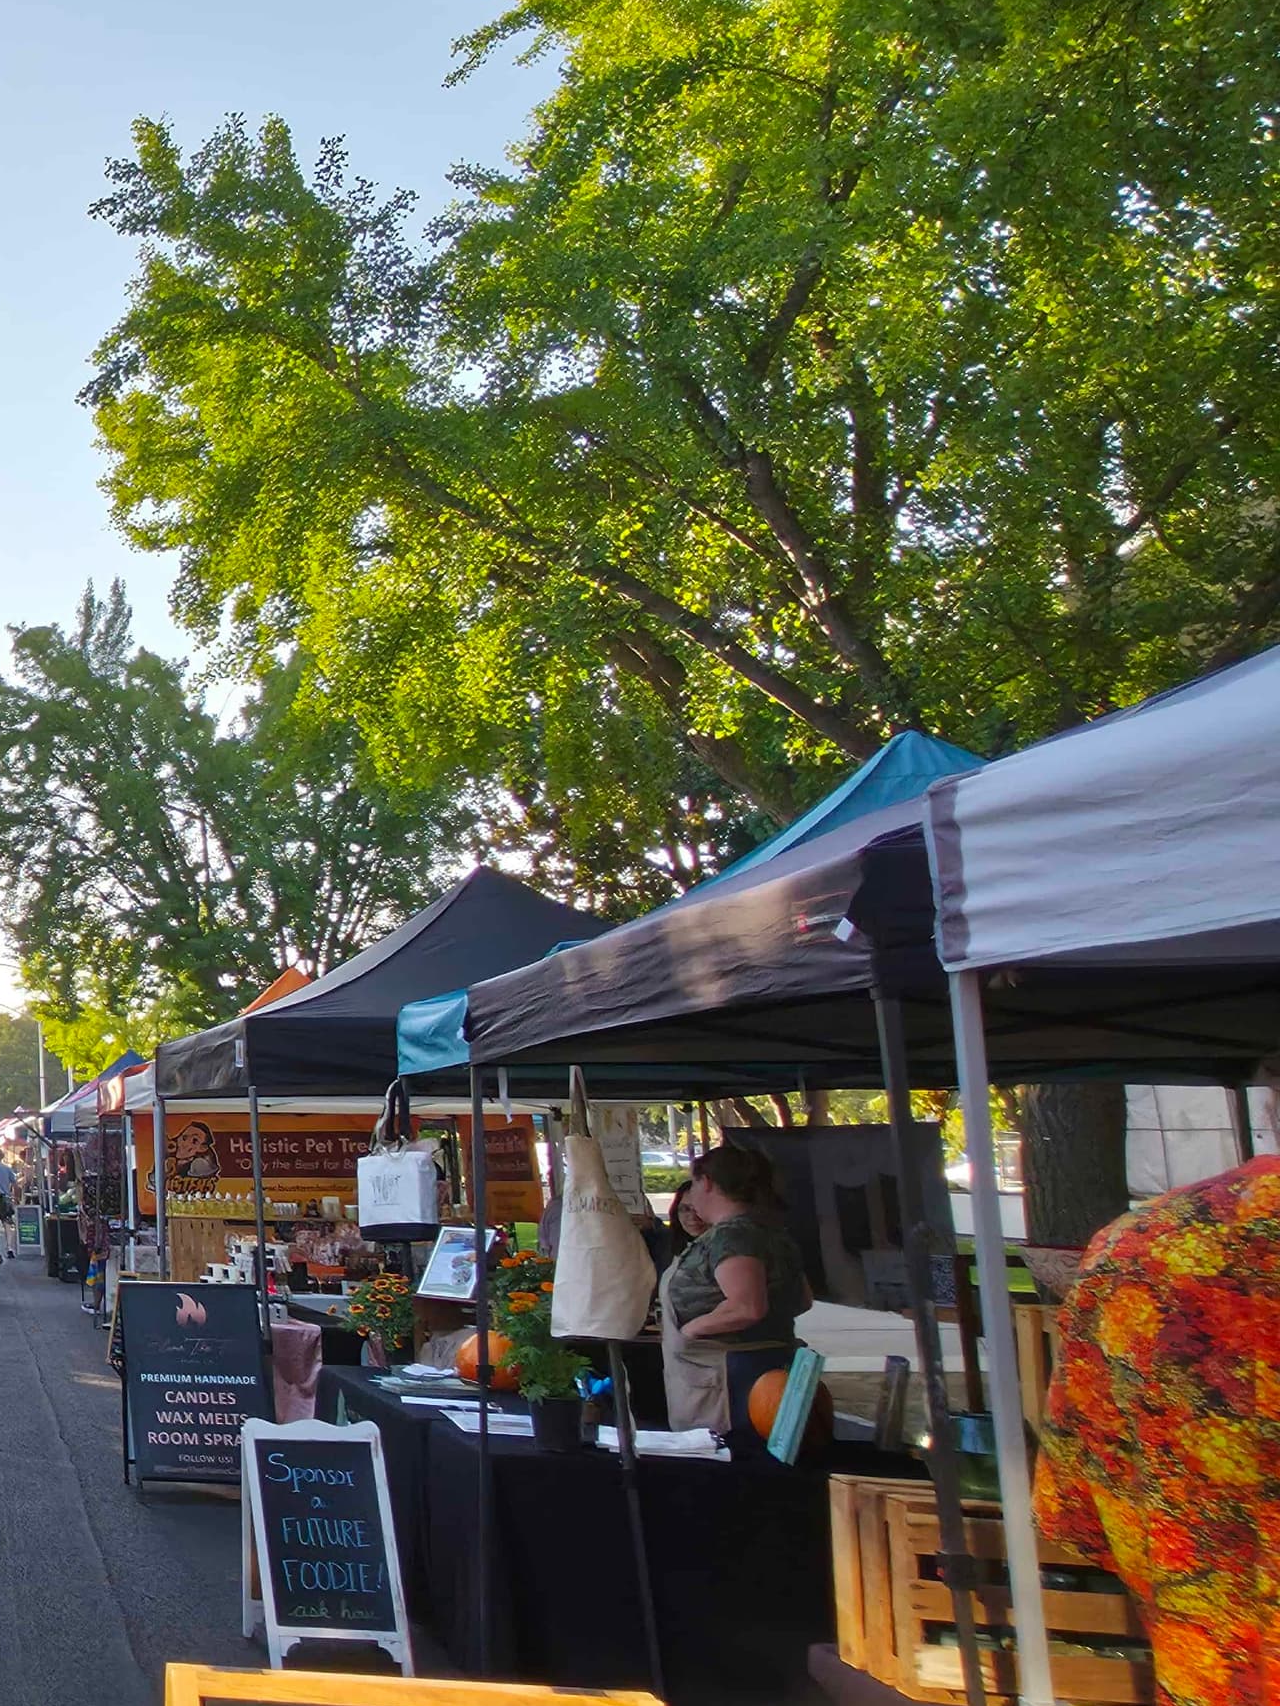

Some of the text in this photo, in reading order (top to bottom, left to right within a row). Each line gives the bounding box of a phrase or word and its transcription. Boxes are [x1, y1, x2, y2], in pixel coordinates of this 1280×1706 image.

[306, 1138, 333, 1153] Pet
[140, 1373, 257, 1385] PREMIUM HANDMADE
[164, 1391, 237, 1405] CANDLES
[156, 1411, 249, 1426] WAX MELTS
[147, 1431, 199, 1445] ROOM
[178, 1454, 215, 1463] FOLLOW
[265, 1452, 355, 1493] Sponsor
[310, 1496, 327, 1509] a
[281, 1517, 371, 1548] FUTURE
[282, 1559, 383, 1593] FOODIE!
[288, 1600, 333, 1619] ask
